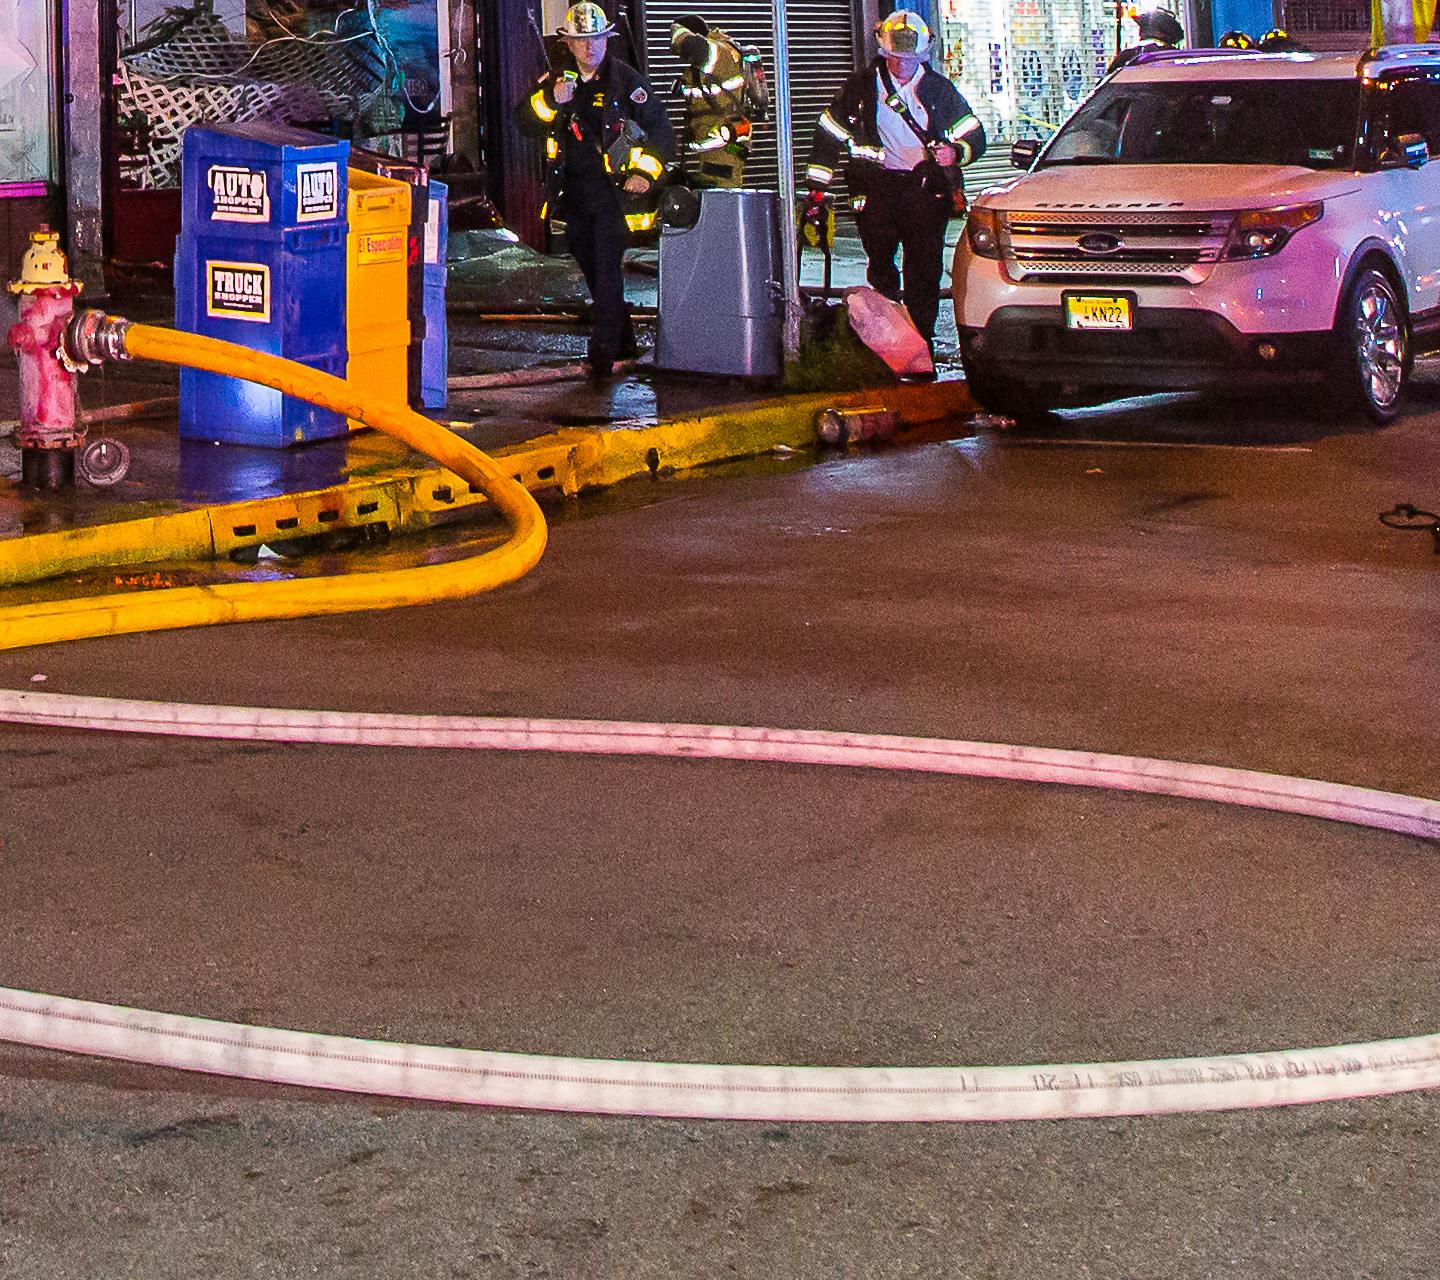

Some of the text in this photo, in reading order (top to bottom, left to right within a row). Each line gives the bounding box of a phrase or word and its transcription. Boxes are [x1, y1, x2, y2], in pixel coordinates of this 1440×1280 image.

[214, 173, 264, 198] AUTO
[303, 171, 333, 197] AUTO
[214, 271, 263, 295] TRUCK
